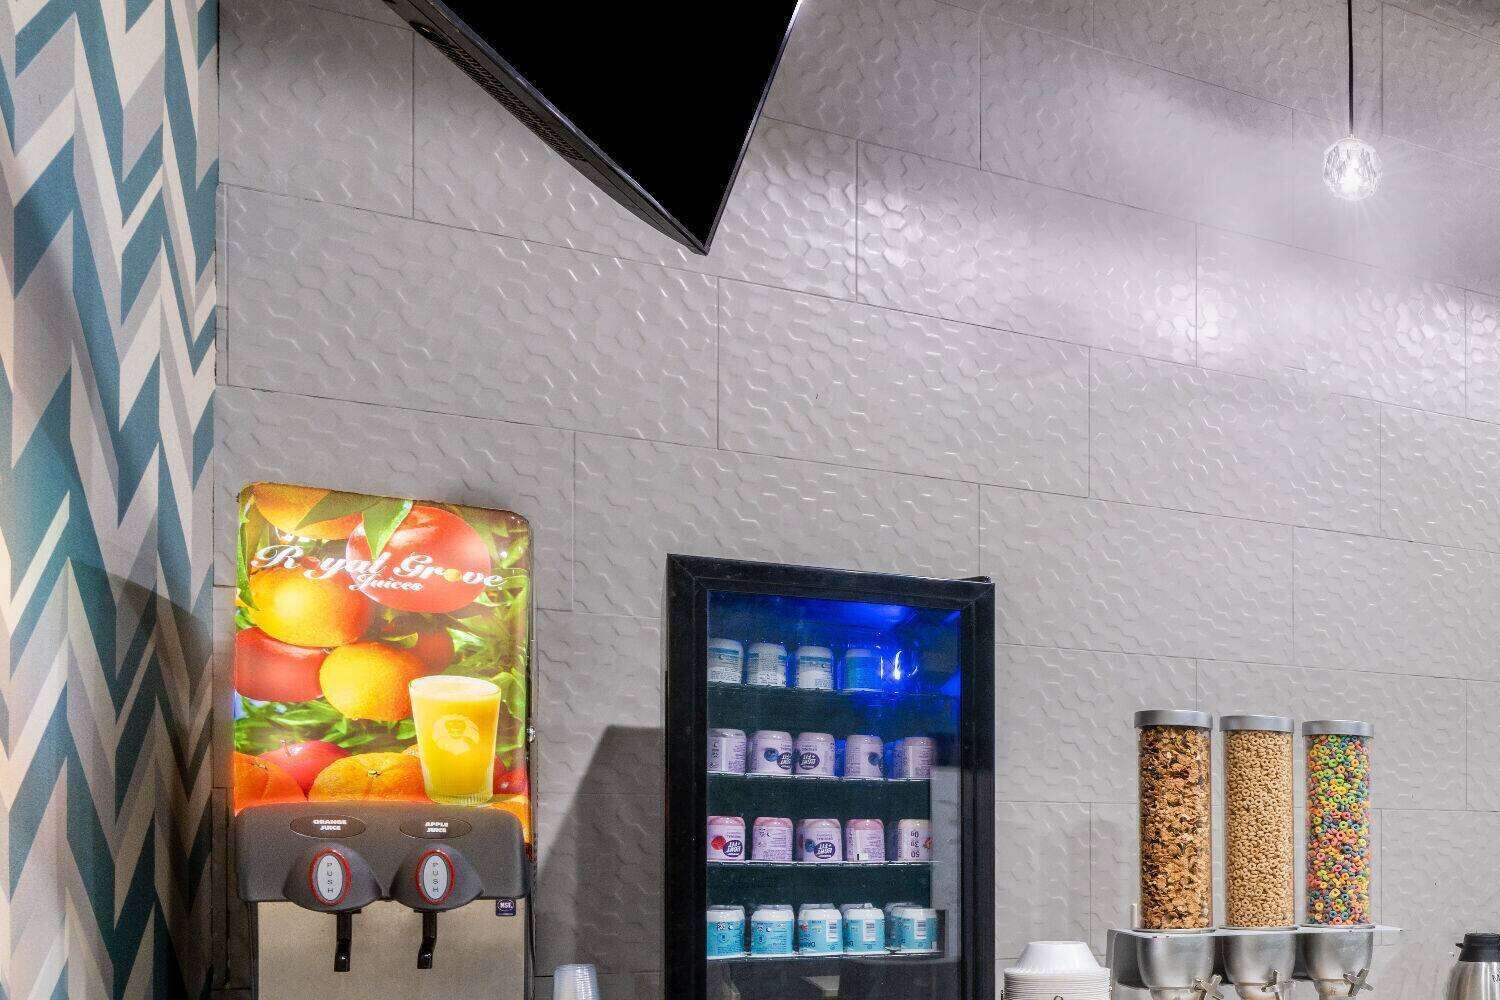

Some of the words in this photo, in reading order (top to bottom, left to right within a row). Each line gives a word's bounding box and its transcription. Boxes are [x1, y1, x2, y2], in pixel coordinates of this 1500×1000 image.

[251, 545, 391, 580] Royal
[393, 552, 505, 587] Grove
[349, 573, 423, 591] Juices
[326, 862, 334, 893] PUSH
